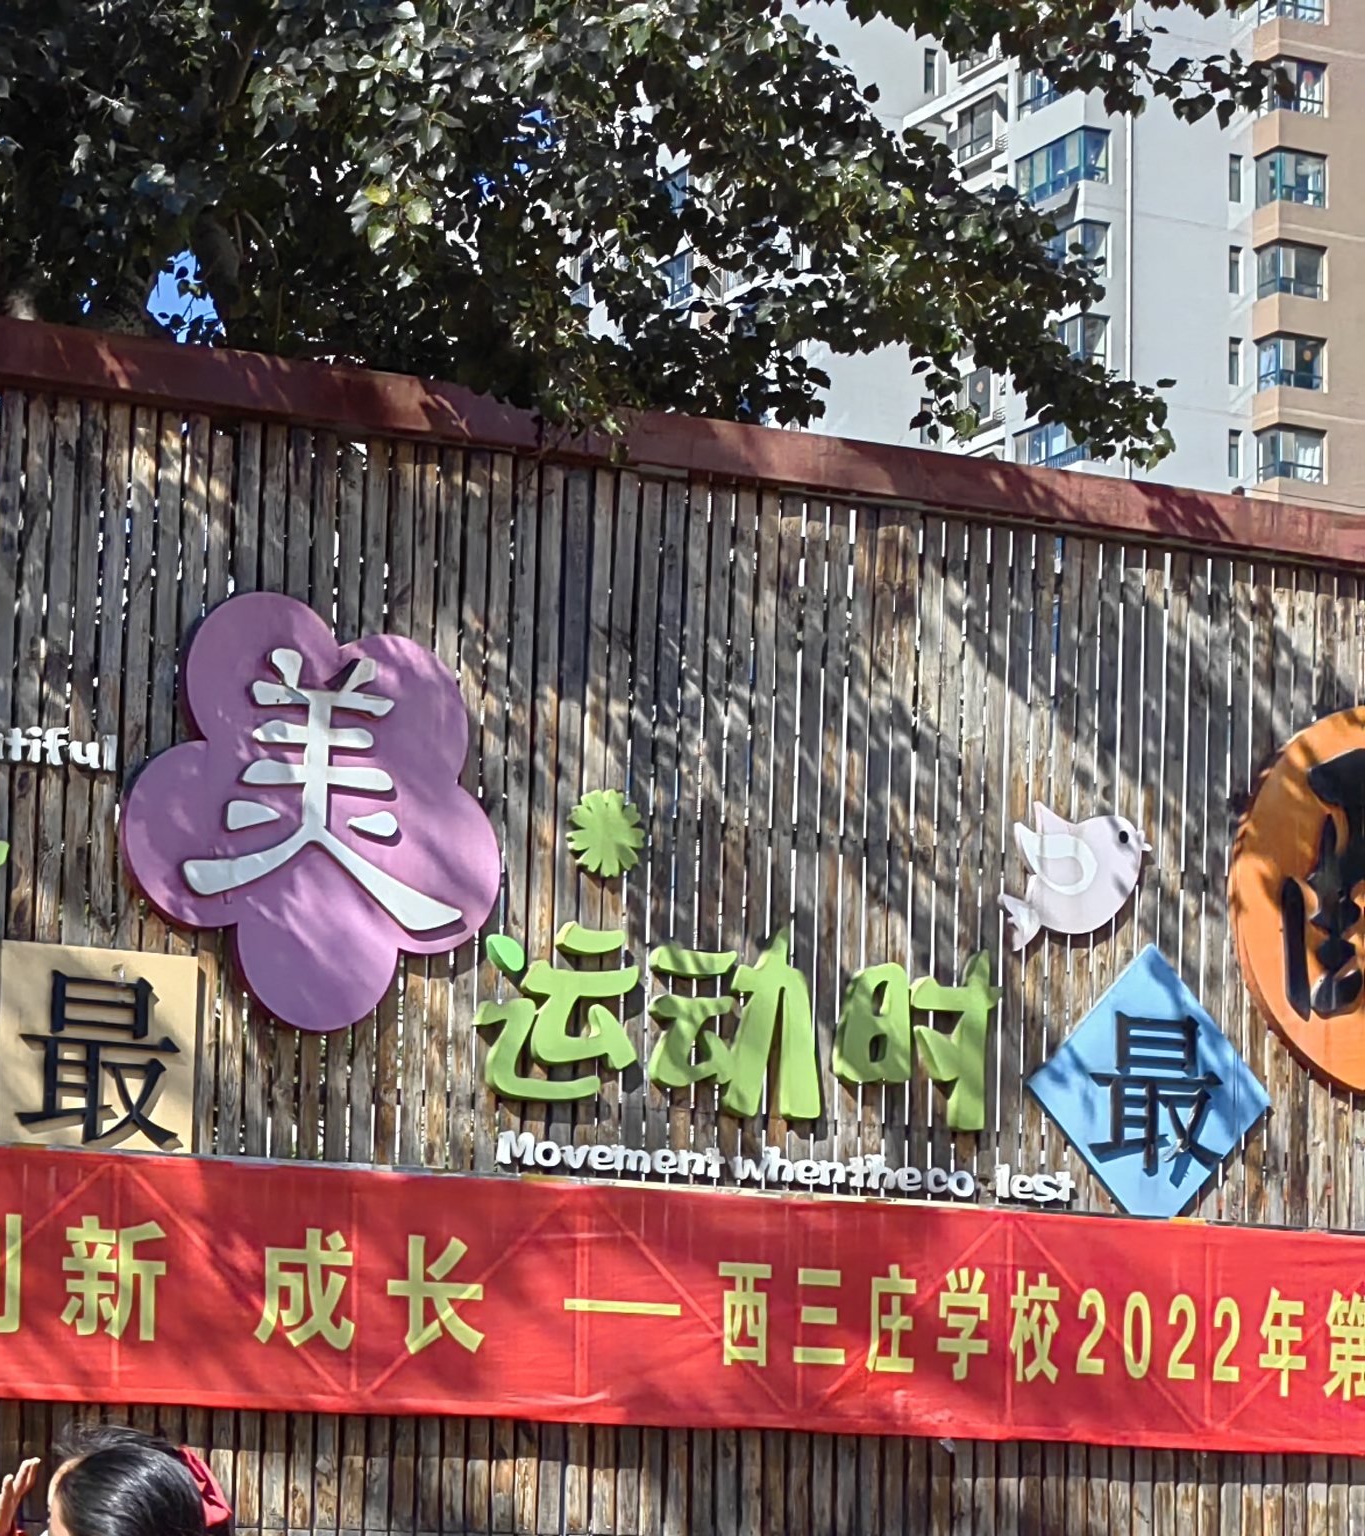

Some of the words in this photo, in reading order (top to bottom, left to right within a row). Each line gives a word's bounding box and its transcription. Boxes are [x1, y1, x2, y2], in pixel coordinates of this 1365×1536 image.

[183, 648, 462, 931] 美
[15, 969, 181, 1150] 最
[472, 918, 1002, 1132] 运动时
[1088, 1010, 1224, 1176] 最
[496, 1130, 723, 1179] Movement
[730, 1145, 846, 1187] when
[846, 1153, 923, 1192] the
[924, 1163, 1076, 1203] colest
[254, 1228, 485, 1353] 成长
